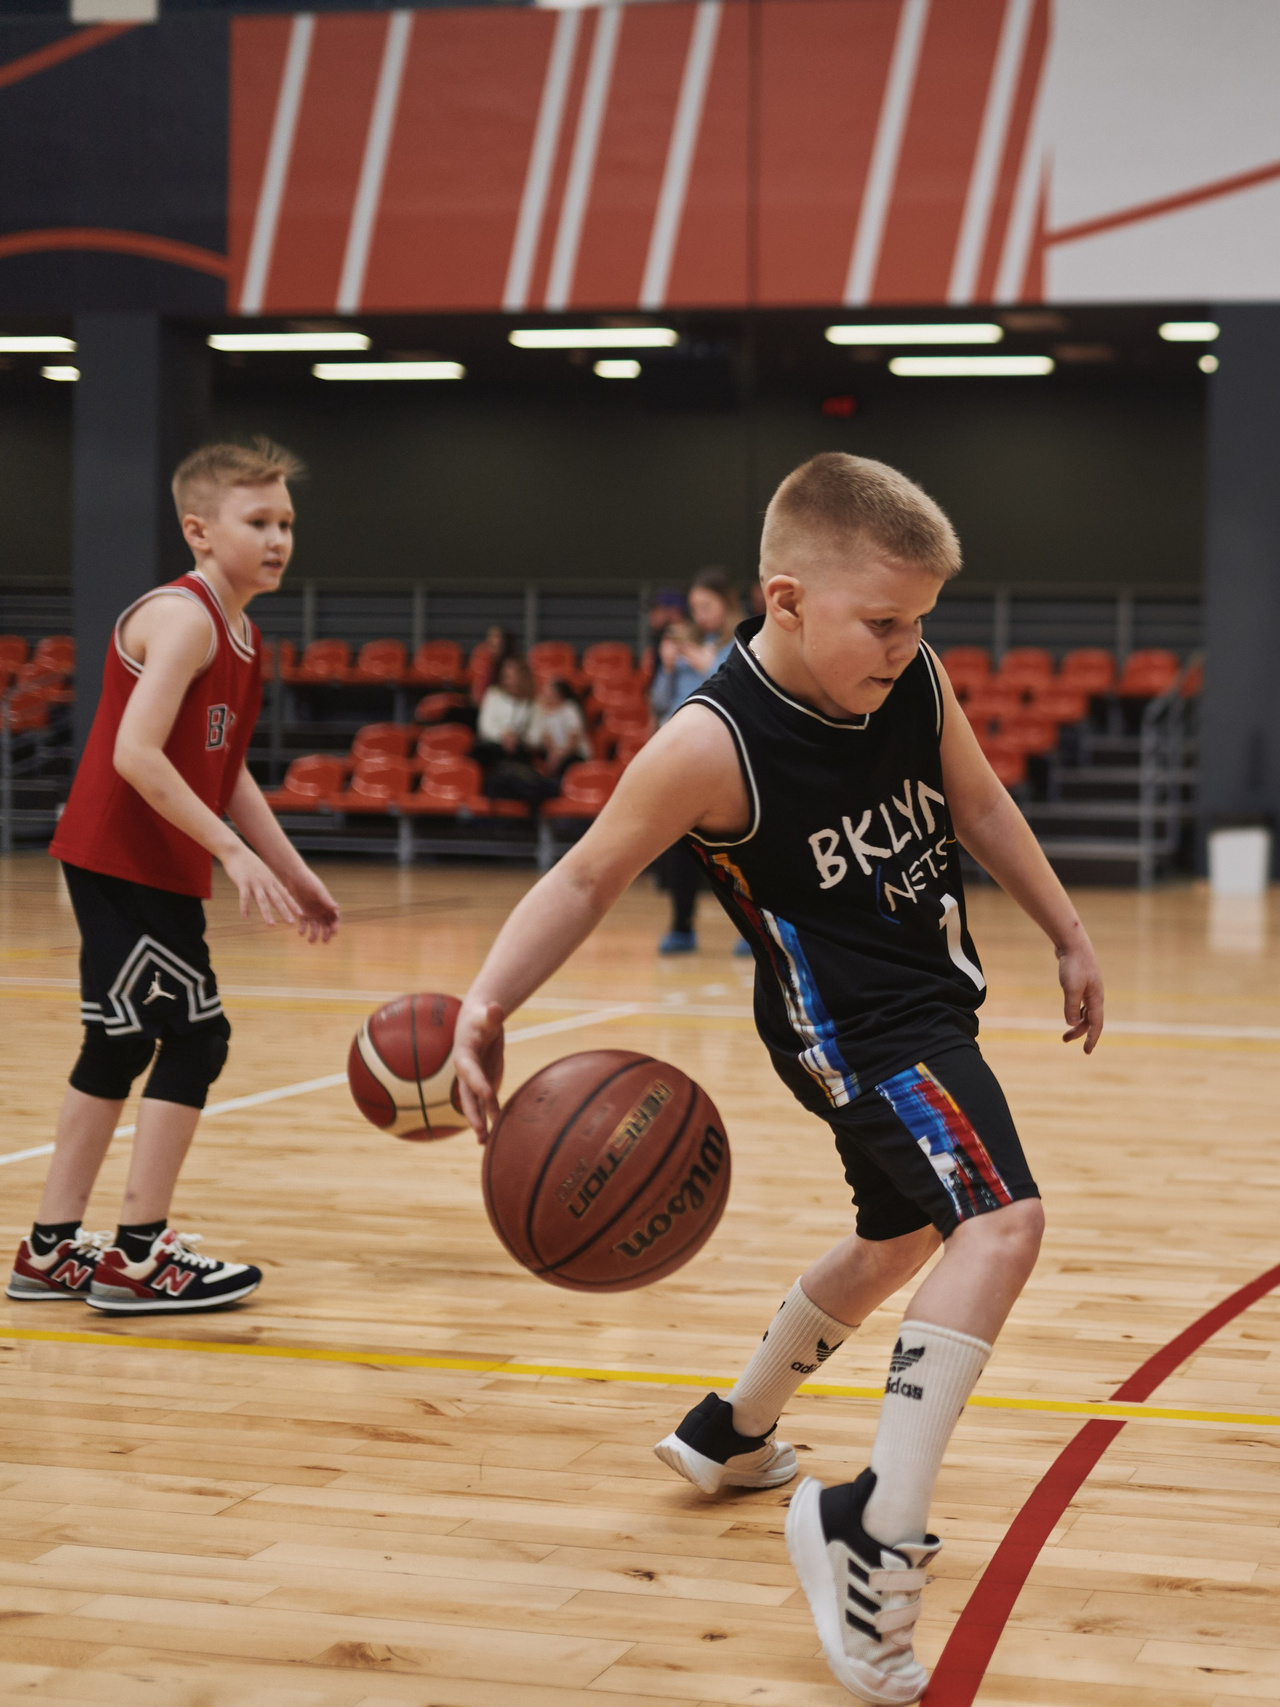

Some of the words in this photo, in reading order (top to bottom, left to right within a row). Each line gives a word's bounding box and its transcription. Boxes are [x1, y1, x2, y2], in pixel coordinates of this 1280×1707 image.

[205, 704, 236, 750] B
[808, 778, 945, 890] BKLYN
[151, 1264, 196, 1297] N
[884, 1376, 924, 1400] idas
